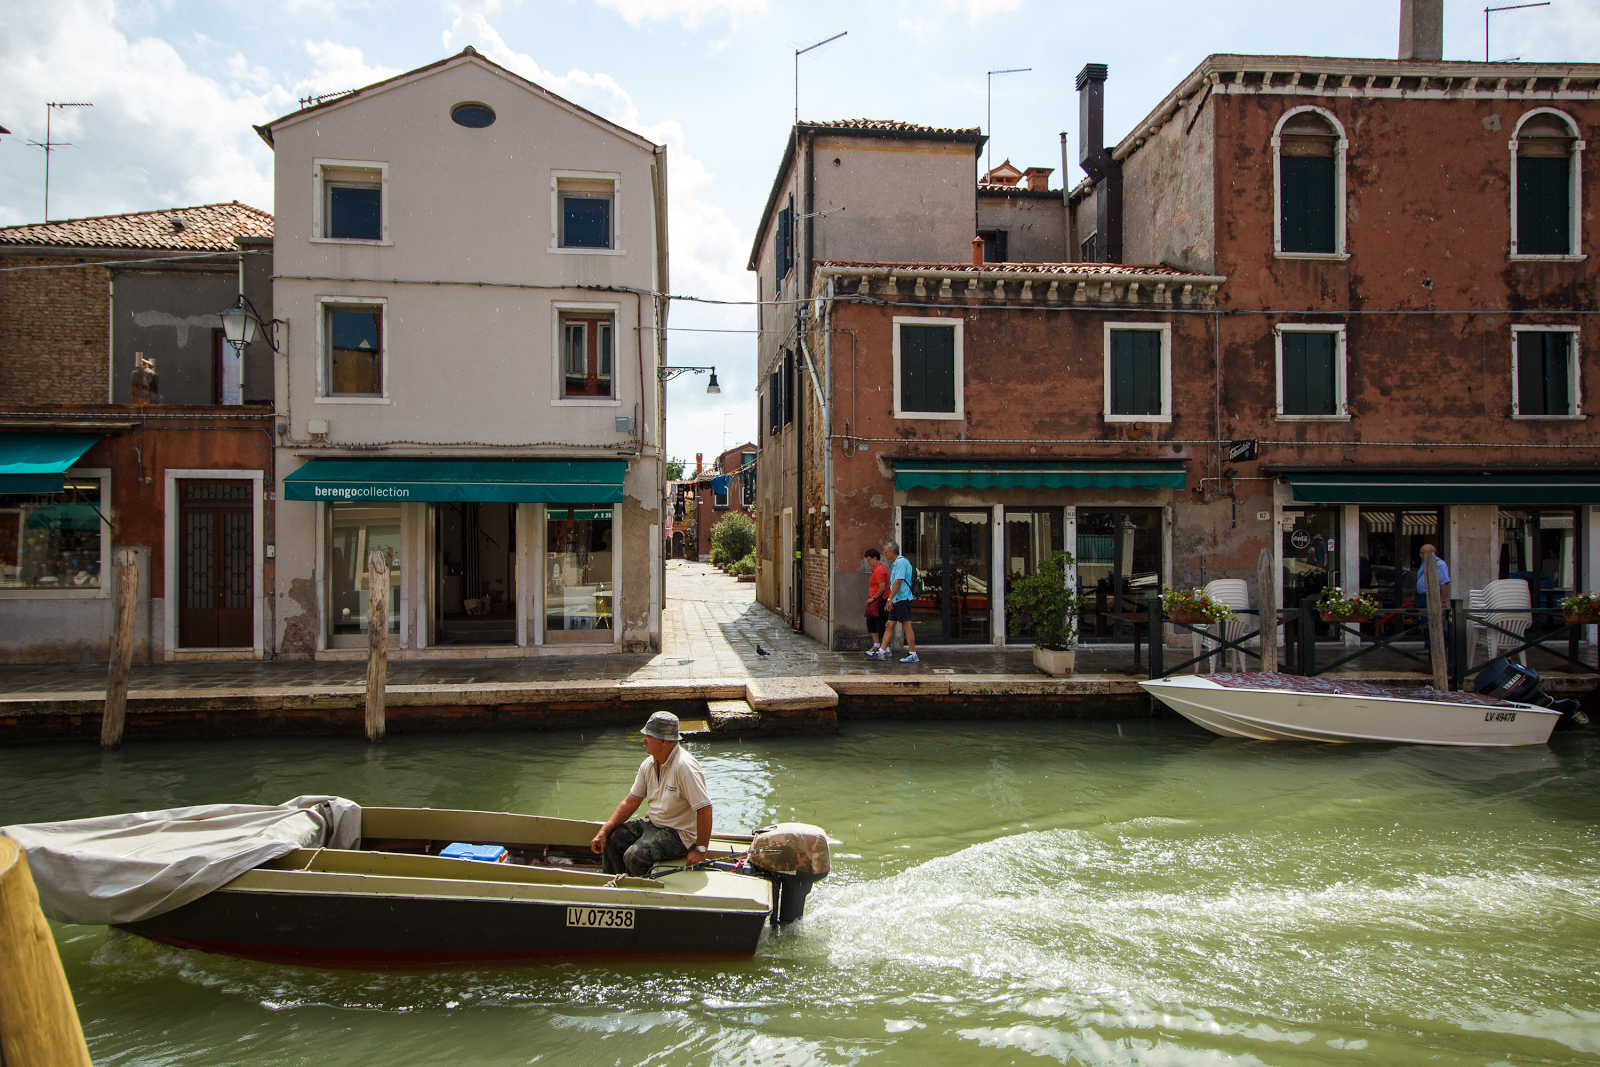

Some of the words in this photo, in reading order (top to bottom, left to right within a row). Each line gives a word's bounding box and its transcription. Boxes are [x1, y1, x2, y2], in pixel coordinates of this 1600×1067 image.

[315, 486, 410, 499] berengocollection
[1502, 673, 1522, 690] YAMAHA
[1484, 712, 1496, 722] LV
[1495, 712, 1516, 722] 49478
